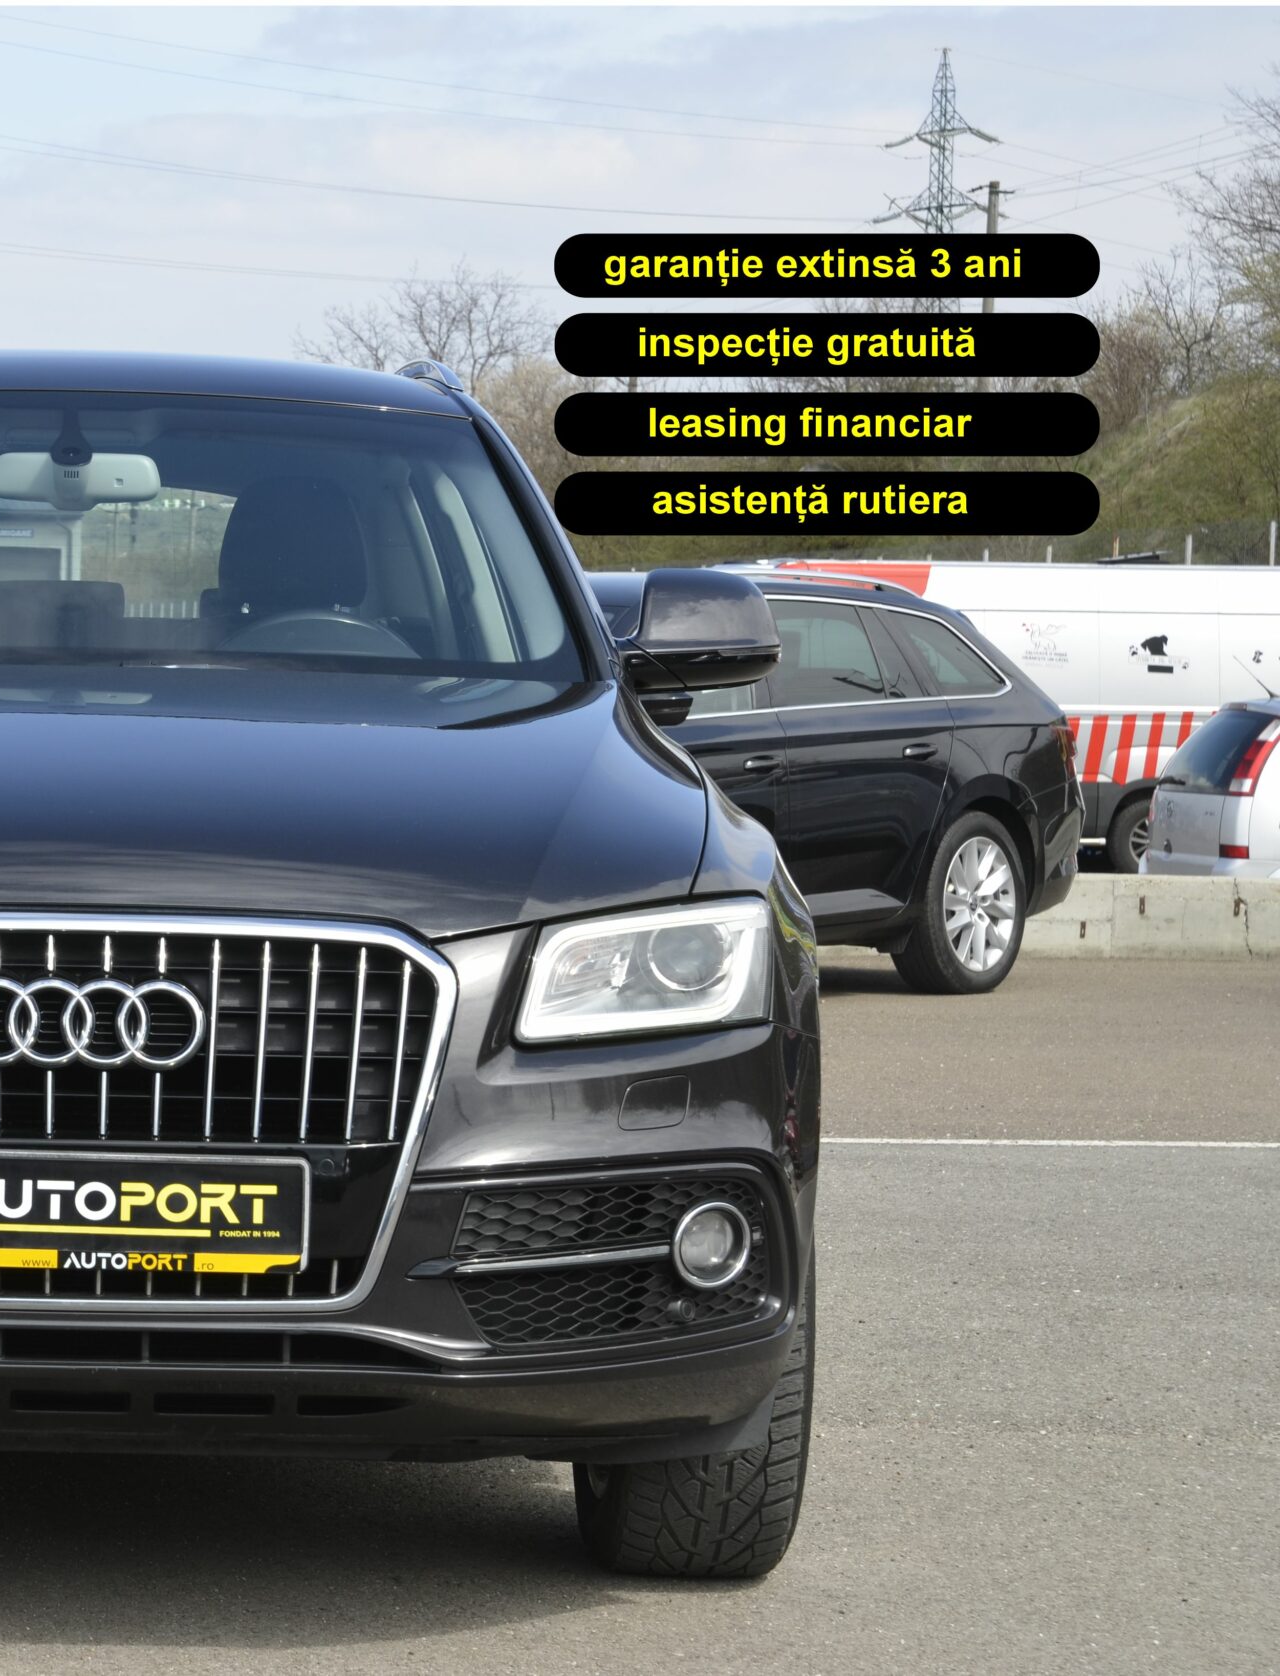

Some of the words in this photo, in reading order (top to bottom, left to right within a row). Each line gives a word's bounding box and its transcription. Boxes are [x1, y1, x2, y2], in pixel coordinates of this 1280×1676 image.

[219, 1230, 251, 1238] FONDAT
[252, 1230, 261, 1238] IN
[263, 1230, 280, 1238] 1994
[63, 1251, 188, 1271] AUTOPORT
